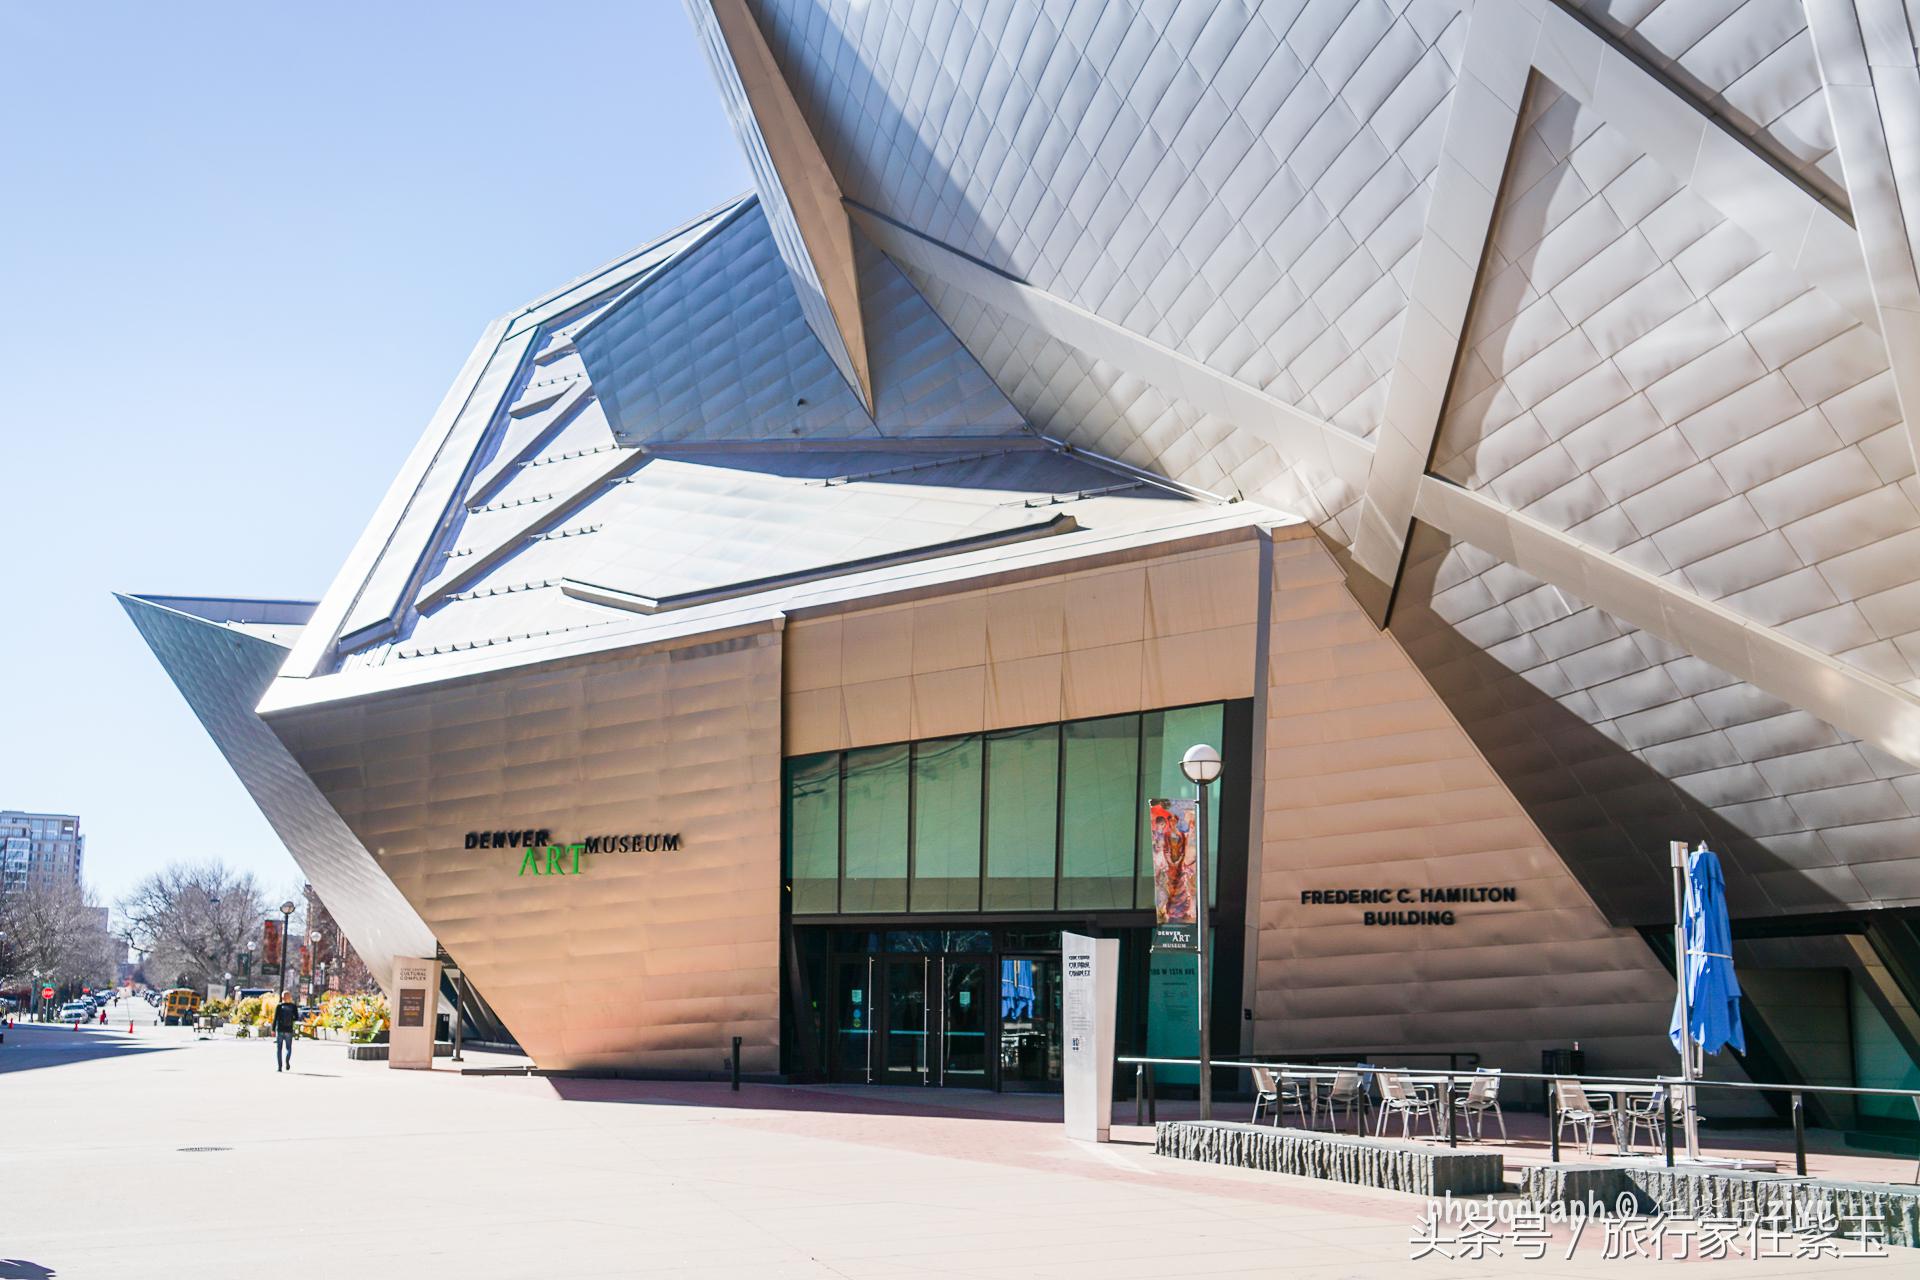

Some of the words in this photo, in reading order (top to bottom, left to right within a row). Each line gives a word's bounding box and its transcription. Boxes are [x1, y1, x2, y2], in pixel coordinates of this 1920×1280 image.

[465, 829, 550, 849] DENVER
[583, 833, 682, 854] MUSEUM
[518, 844, 586, 877] ART
[1301, 888, 1392, 905] FREDERIC
[1397, 888, 1415, 904] C.
[1420, 886, 1517, 903] HAMILTON
[1363, 910, 1456, 926] BUILDING
[1172, 934, 1191, 942] ART
